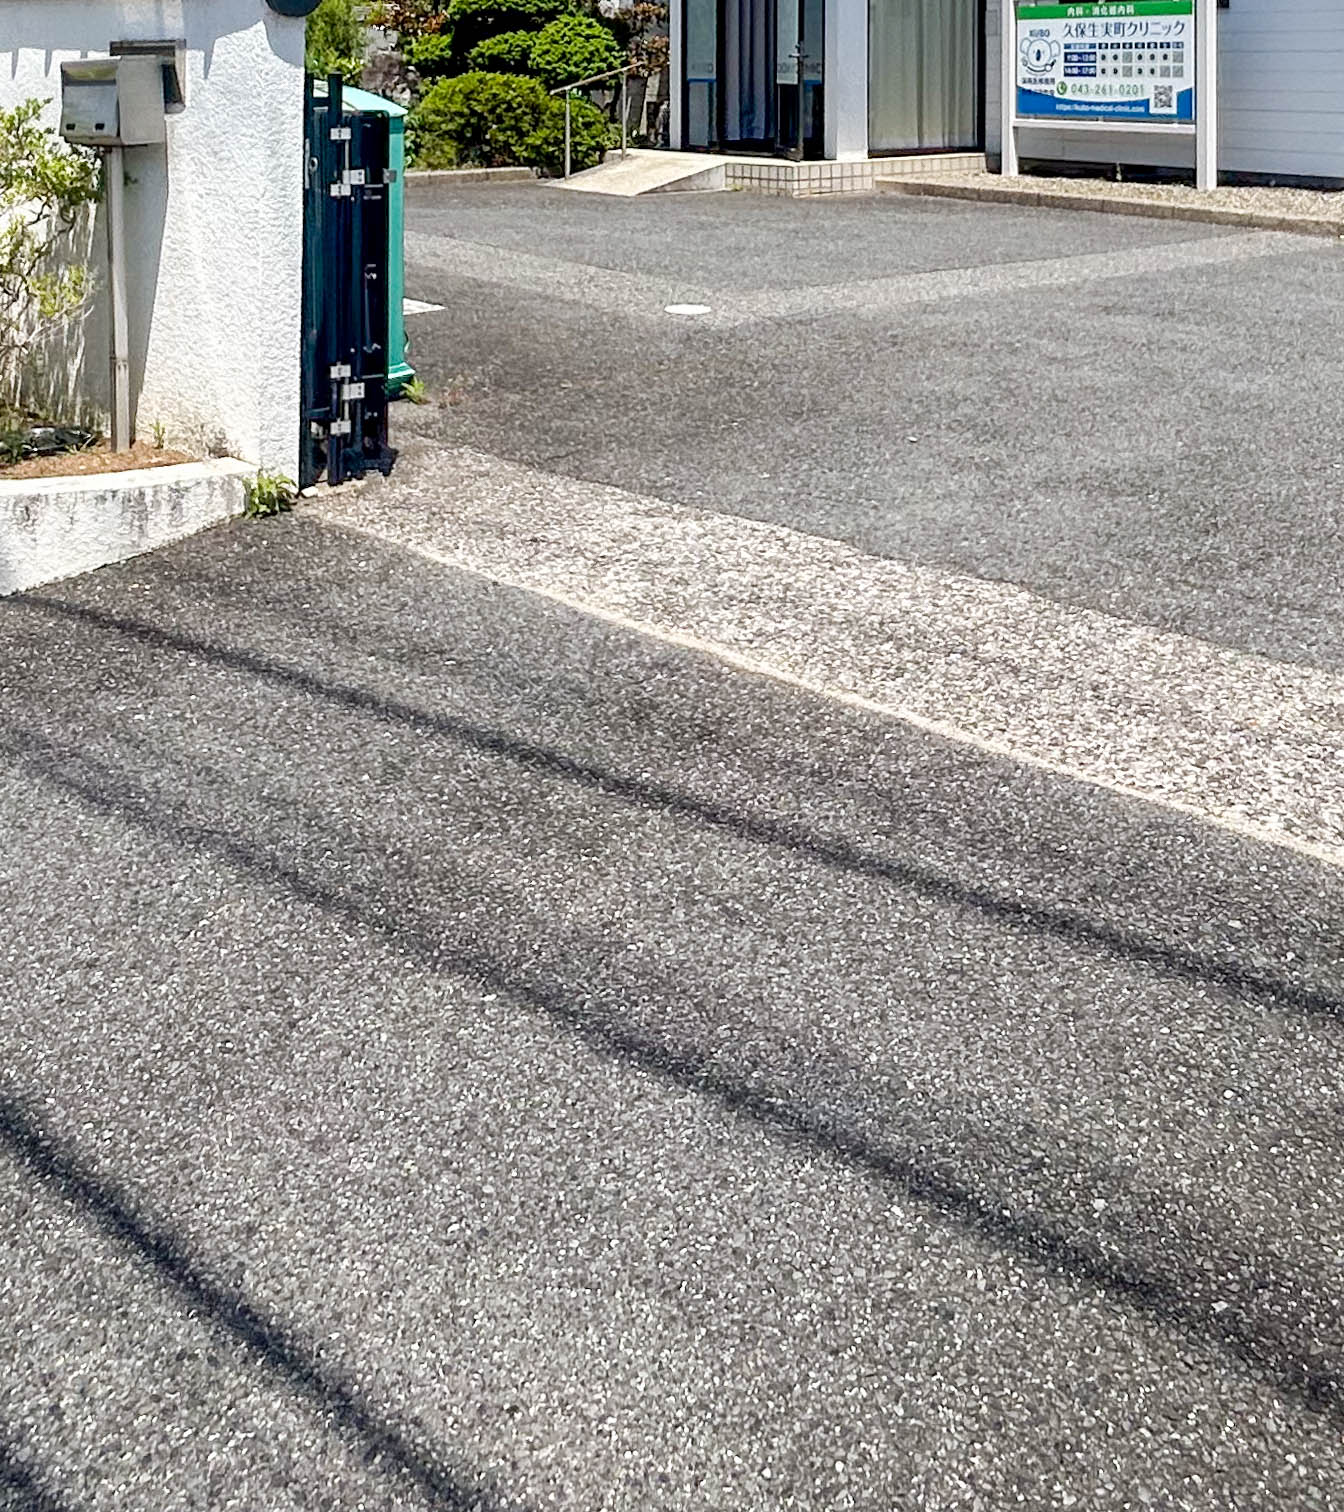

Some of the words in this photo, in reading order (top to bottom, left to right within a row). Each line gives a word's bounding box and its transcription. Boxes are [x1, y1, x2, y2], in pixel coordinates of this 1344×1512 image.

[1063, 20, 1185, 38] 久保生実町クリニック
